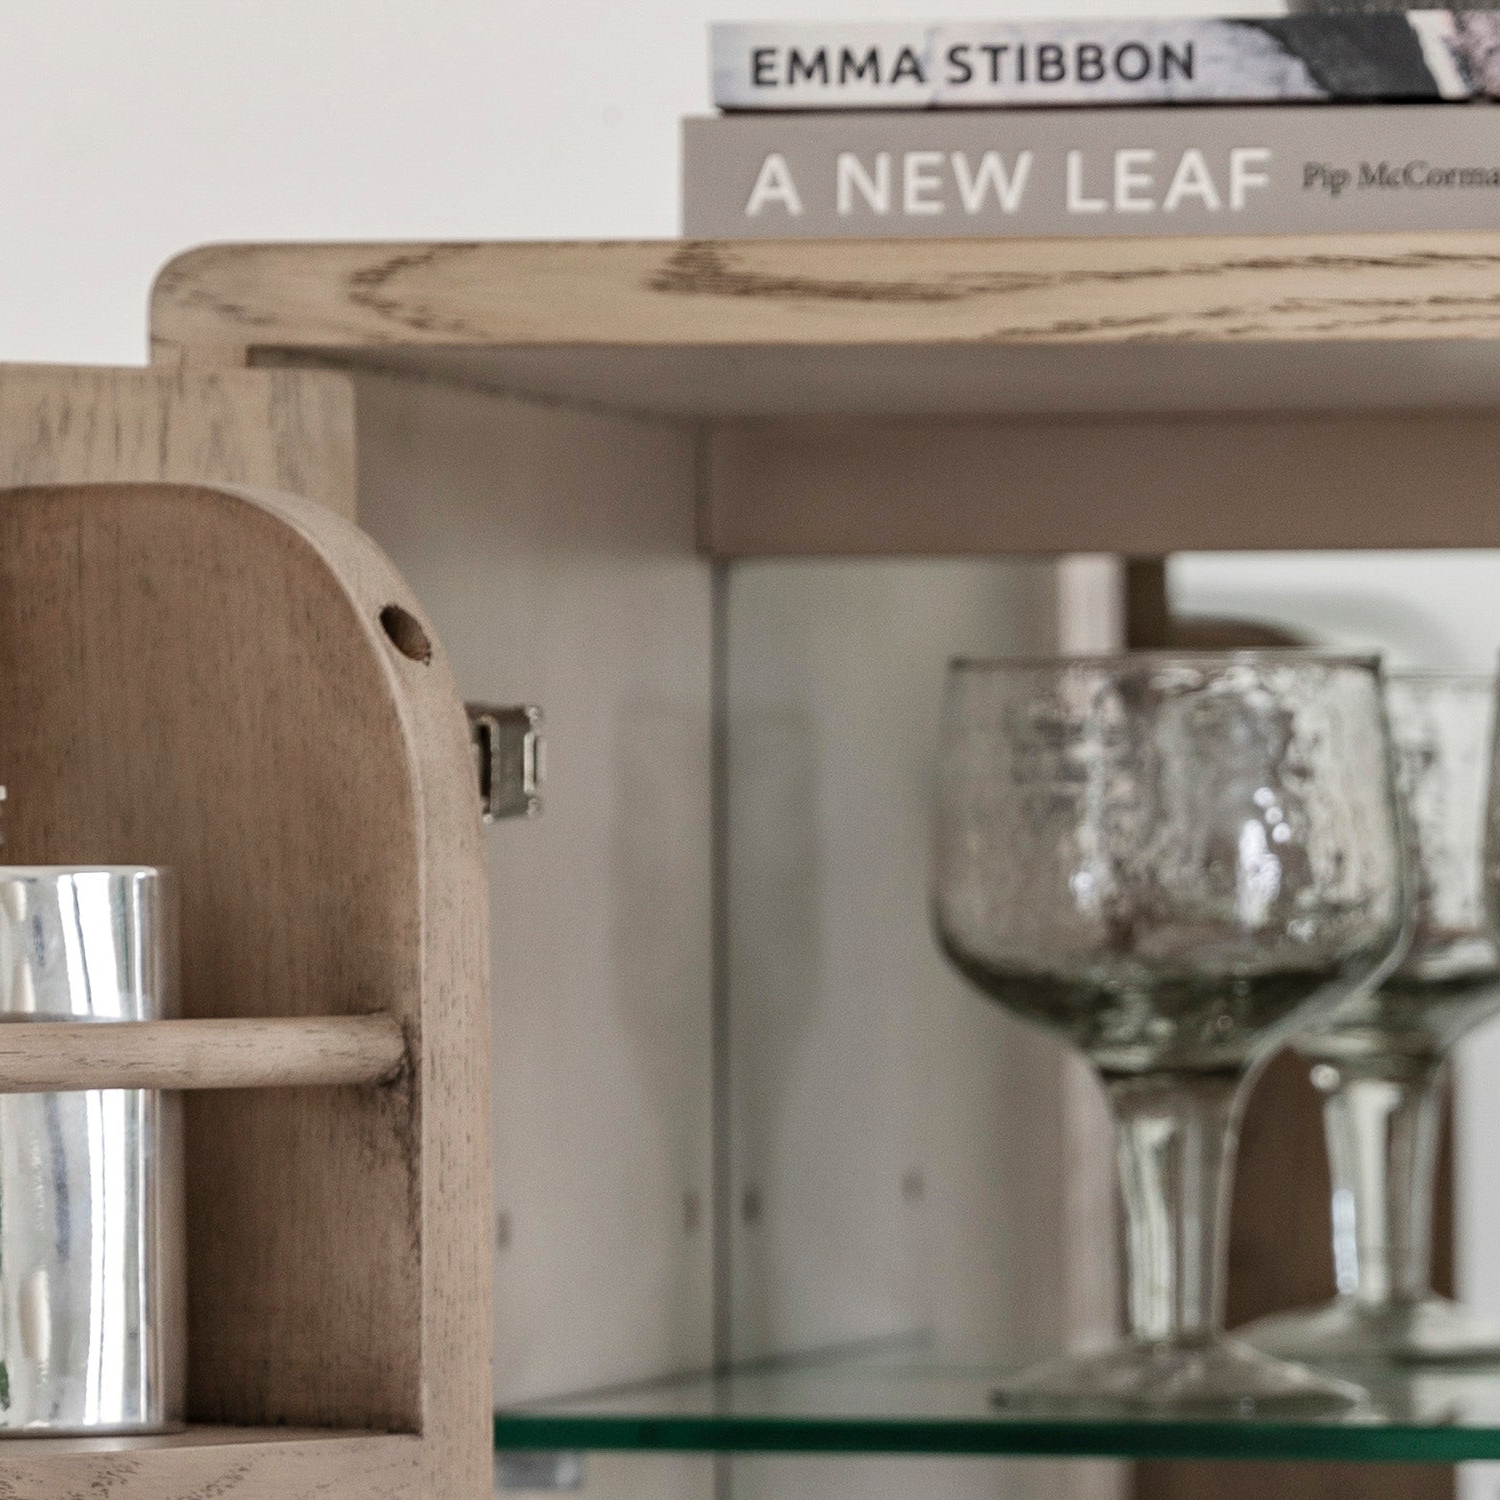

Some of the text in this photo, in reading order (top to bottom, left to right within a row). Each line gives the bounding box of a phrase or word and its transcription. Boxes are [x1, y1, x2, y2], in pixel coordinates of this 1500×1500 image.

[750, 41, 1196, 88] EMMA STIBBON
[745, 147, 1273, 217] A NEW LEAF
[1303, 161, 1351, 198] Pip
